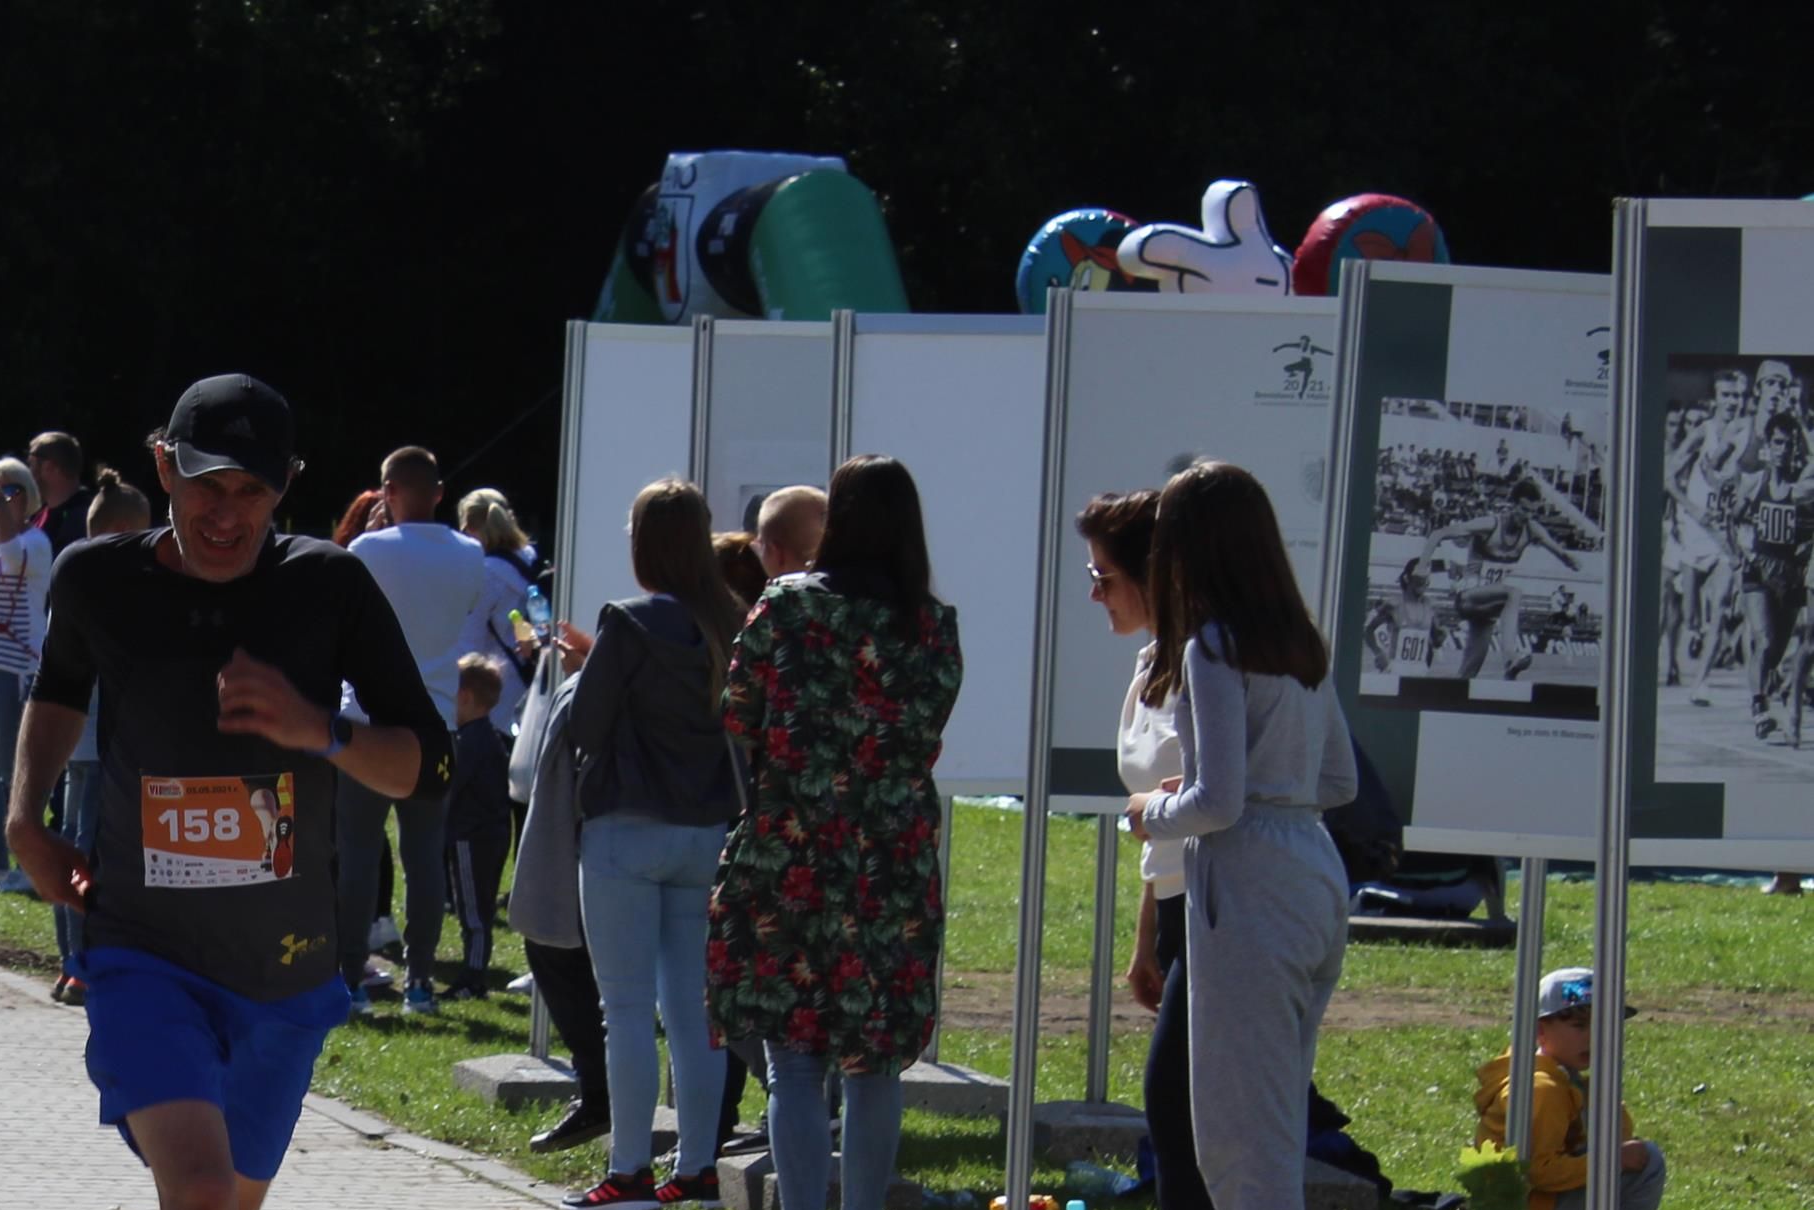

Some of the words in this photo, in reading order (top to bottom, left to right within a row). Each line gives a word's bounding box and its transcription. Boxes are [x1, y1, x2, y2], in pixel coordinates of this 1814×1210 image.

[1761, 506, 1794, 542] 906
[1401, 636, 1425, 661] 601
[158, 808, 240, 842] 158
